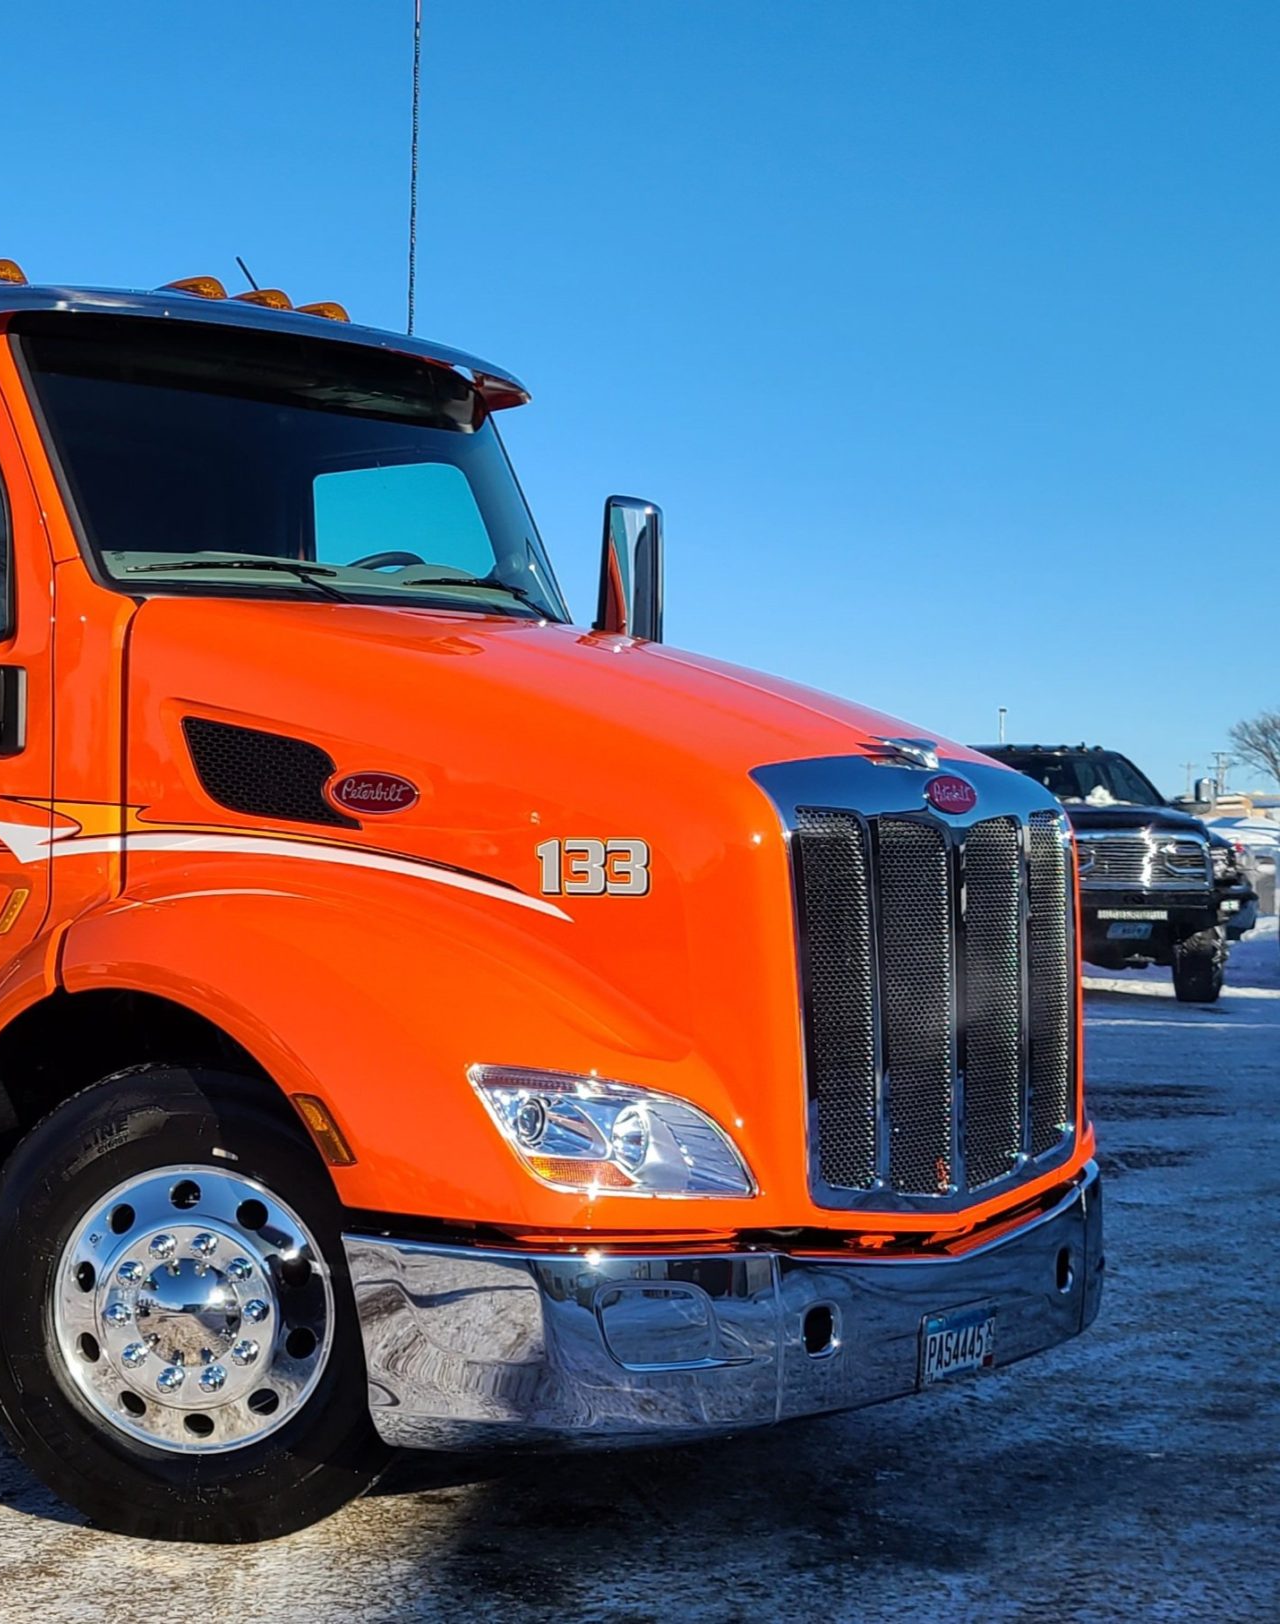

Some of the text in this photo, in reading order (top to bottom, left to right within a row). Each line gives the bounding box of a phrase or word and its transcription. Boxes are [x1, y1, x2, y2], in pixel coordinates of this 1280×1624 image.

[340, 777, 408, 803] Peterbilt
[535, 836, 651, 898] 133
[927, 1325, 984, 1373] PAS4445
